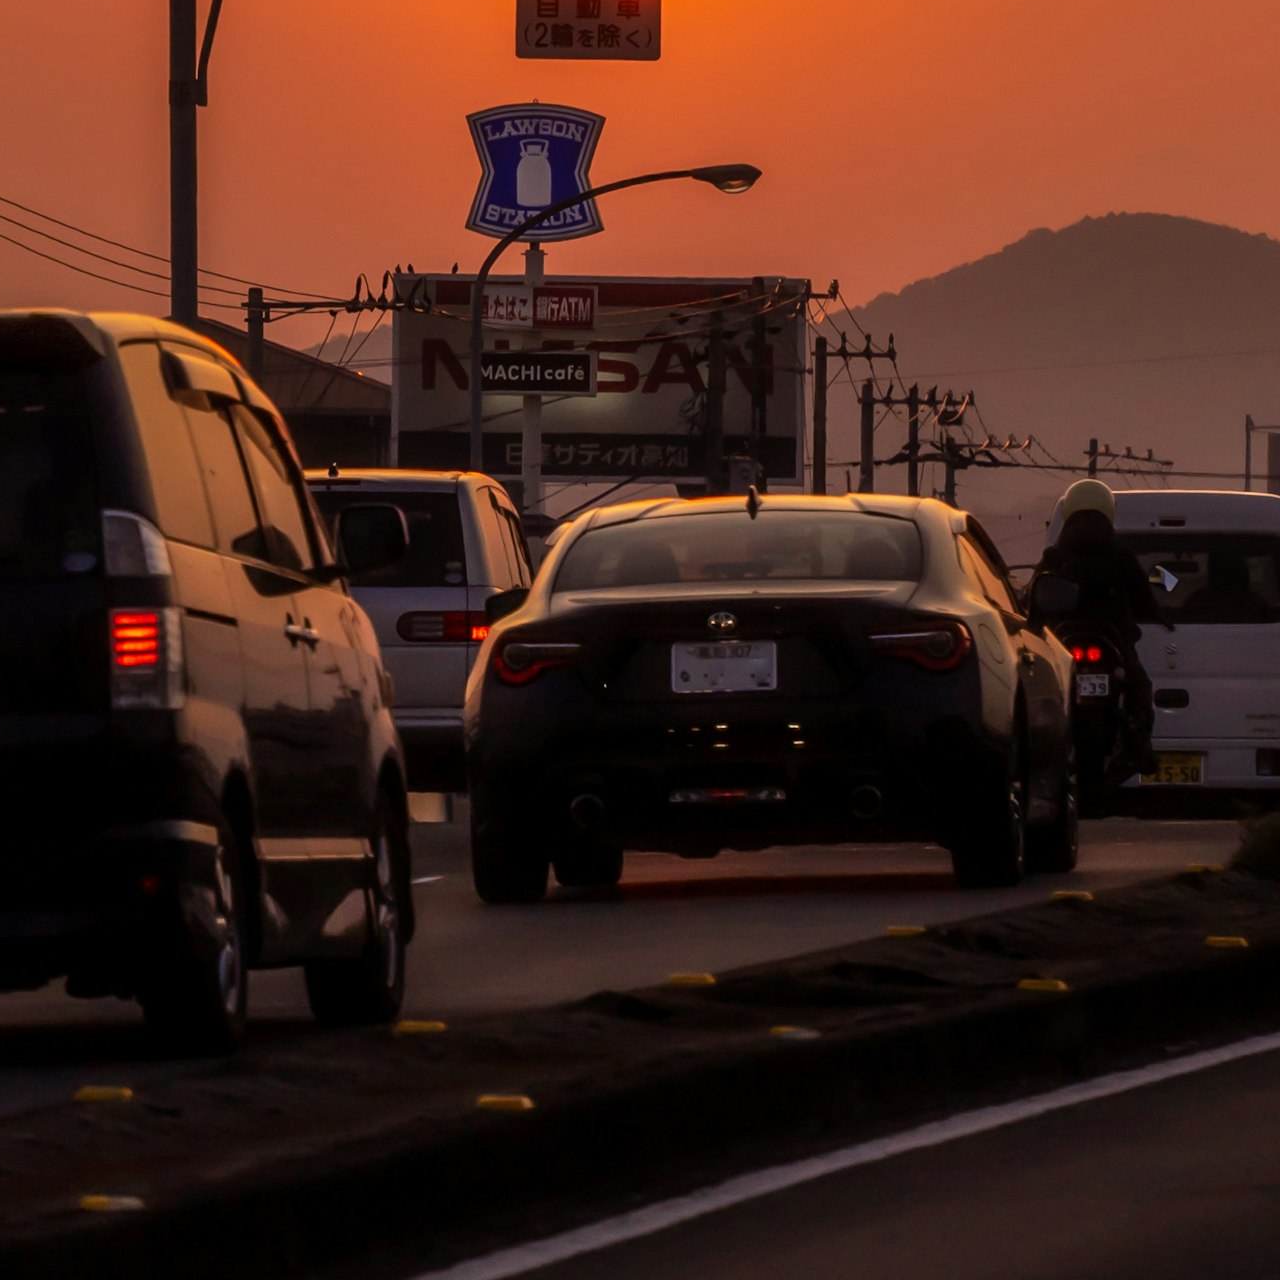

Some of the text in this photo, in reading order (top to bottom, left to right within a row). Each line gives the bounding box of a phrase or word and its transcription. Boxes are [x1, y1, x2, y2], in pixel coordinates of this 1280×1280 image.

[524, 22, 652, 49] (2輪を除く)
[483, 118, 586, 143] LAWSON
[422, 338, 773, 395] NSAN
[480, 364, 585, 381] MACHI café
